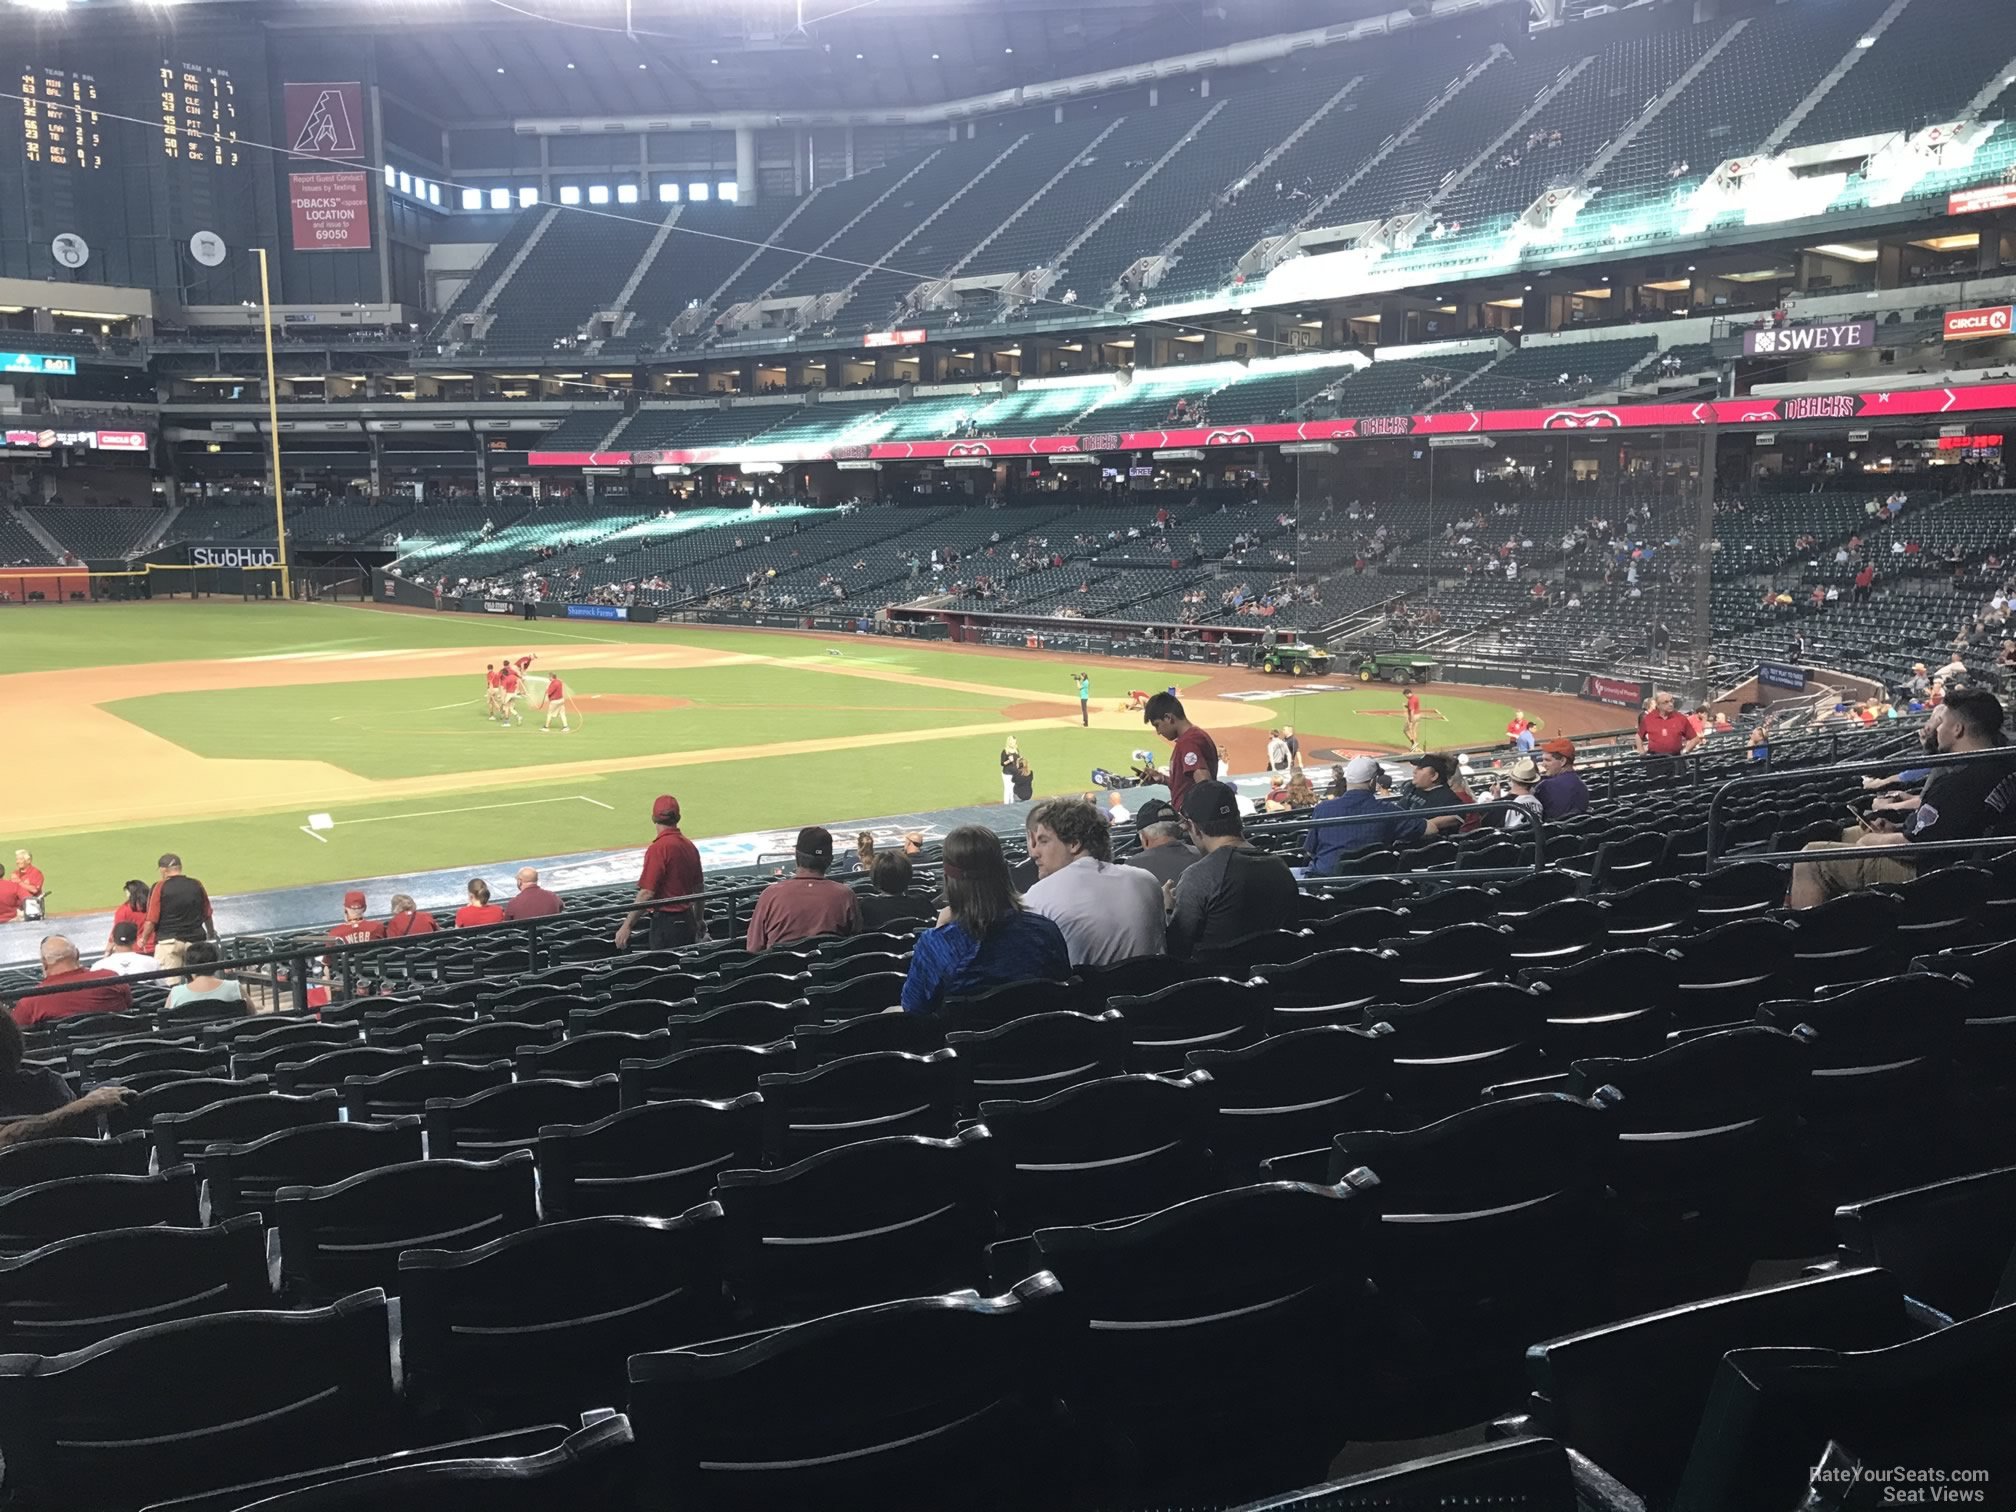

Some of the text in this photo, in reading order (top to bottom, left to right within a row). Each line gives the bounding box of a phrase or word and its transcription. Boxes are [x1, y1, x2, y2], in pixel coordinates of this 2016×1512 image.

[160, 68, 217, 87] 37 COL 4
[184, 83, 198, 92] PHI
[162, 92, 174, 102] 43
[185, 97, 199, 106] CLE
[186, 106, 200, 115] CIN
[212, 110, 219, 119] 2
[163, 115, 176, 125] 45
[187, 120, 201, 128] PIT
[215, 146, 222, 154] 3
[334, 184, 356, 192] Texting
[306, 210, 354, 220] LOCATION
[316, 230, 348, 240] 69050
[1949, 316, 1988, 330] CIRCLE
[1778, 324, 1861, 350] SWEYE
[1784, 395, 1854, 419] DBACKS
[1360, 417, 1408, 436] DBACKS
[194, 548, 274, 567] StubHub
[568, 606, 614, 617] Shamrock Farms
[345, 931, 370, 944] WEBB
